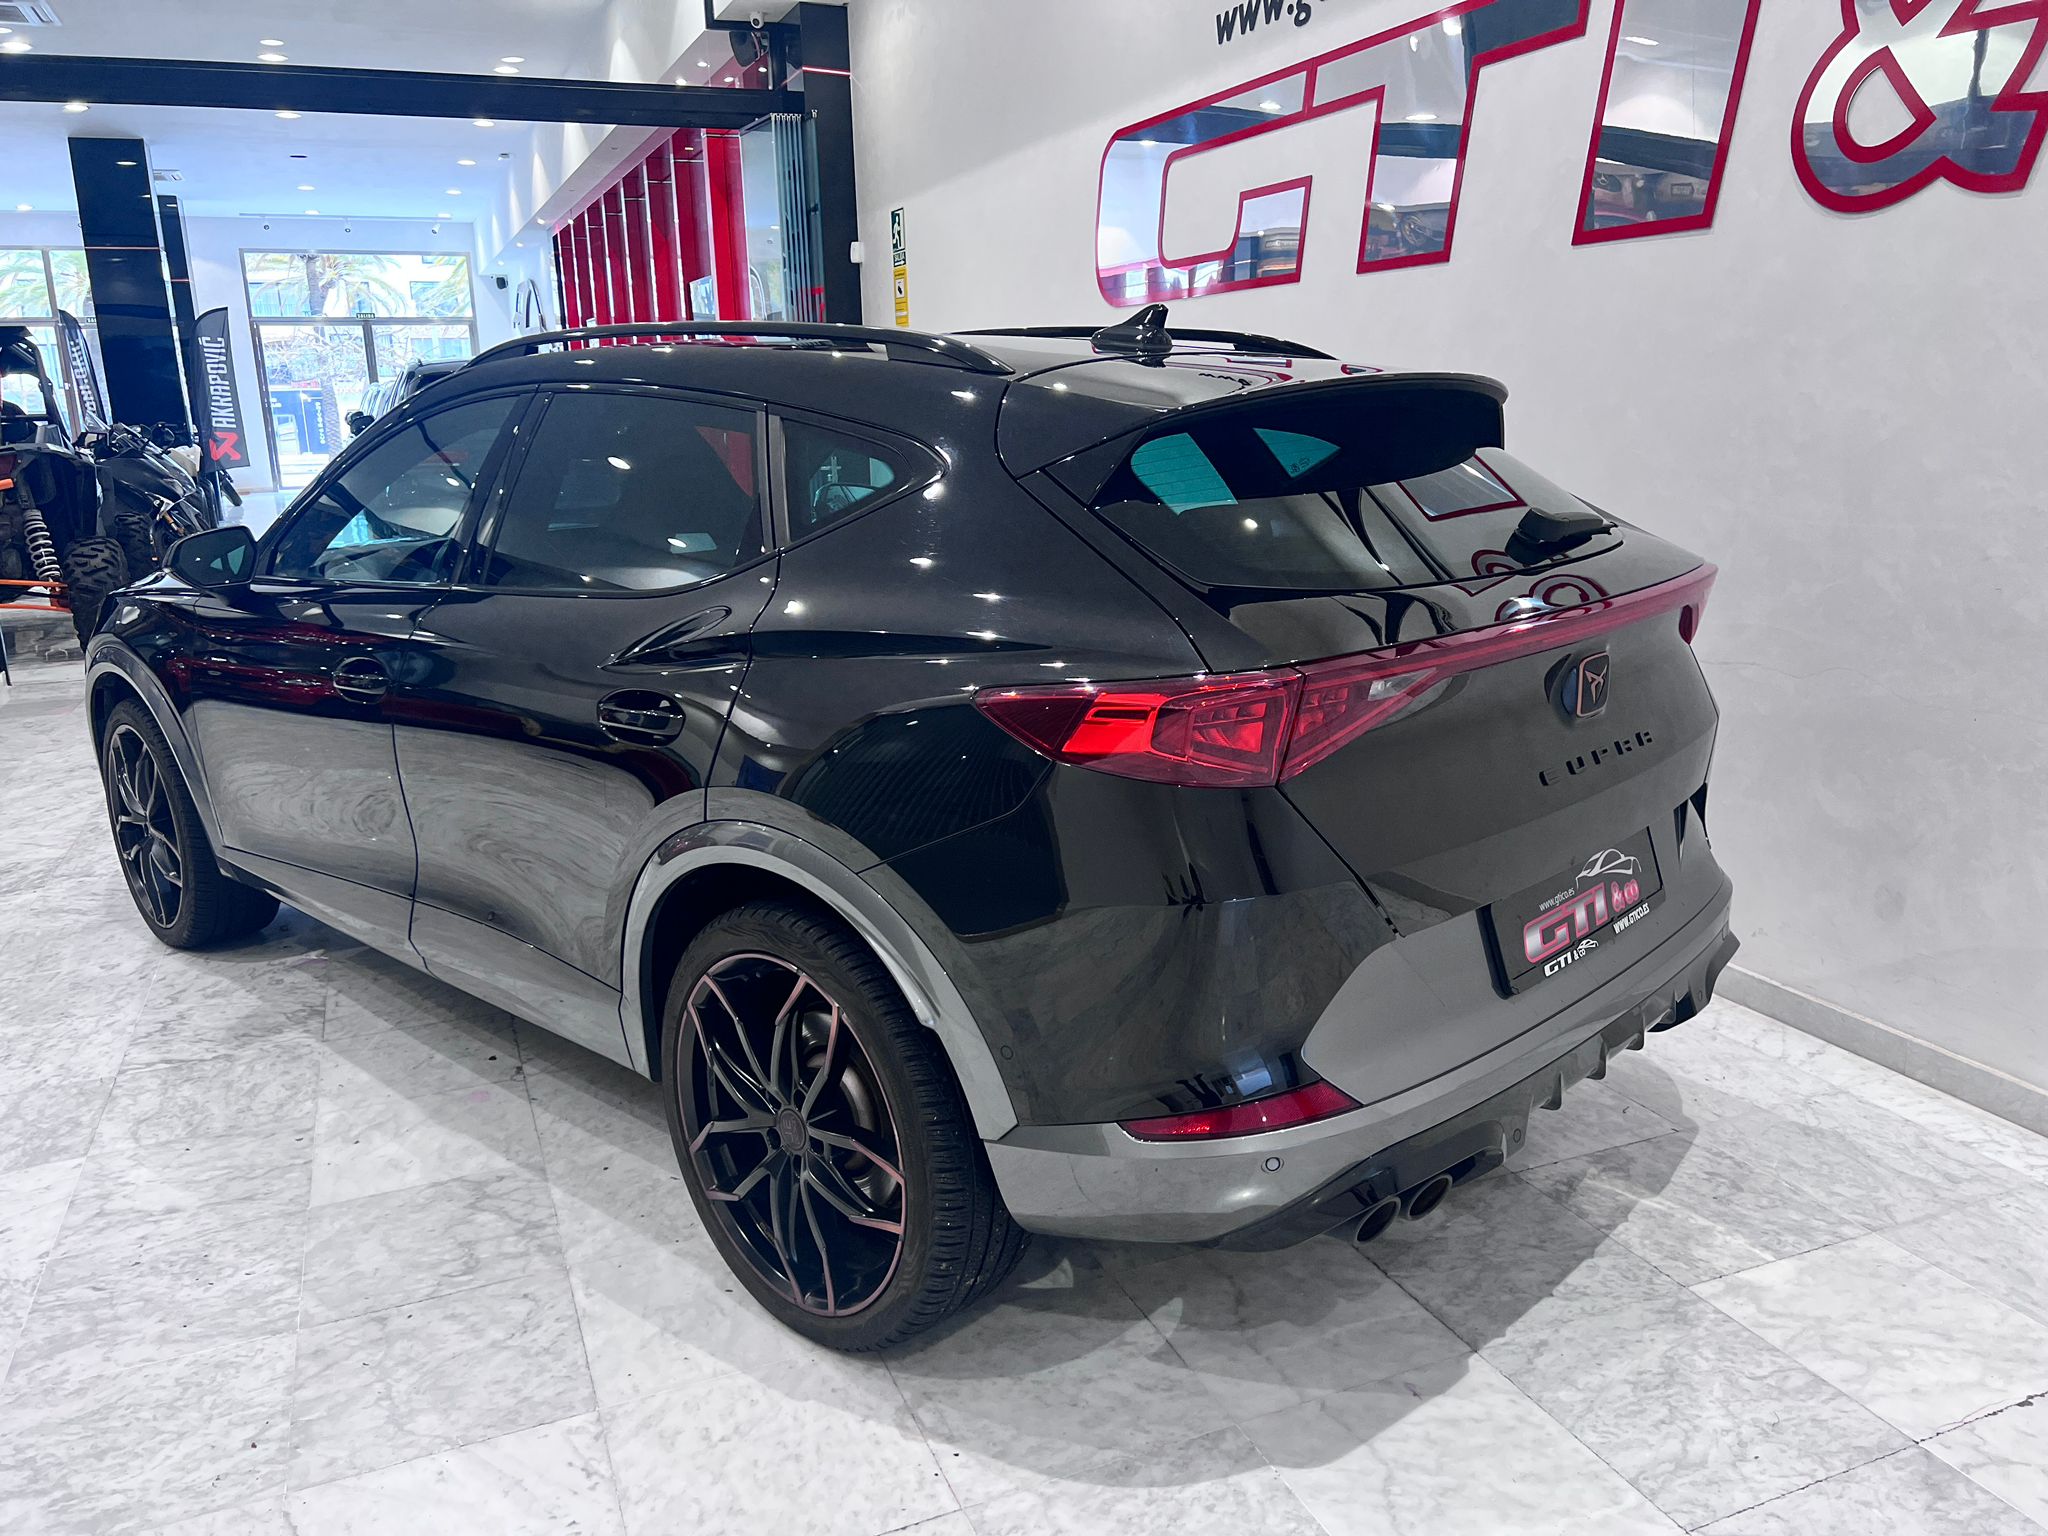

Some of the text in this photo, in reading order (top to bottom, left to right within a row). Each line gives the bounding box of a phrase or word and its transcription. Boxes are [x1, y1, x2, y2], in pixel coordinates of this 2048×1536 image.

[1216, 0, 1325, 45] www.g
[1524, 882, 1608, 963] GTI
[1613, 902, 1650, 934] WWW.GTICO.ES
[1544, 951, 1572, 977] GTI
